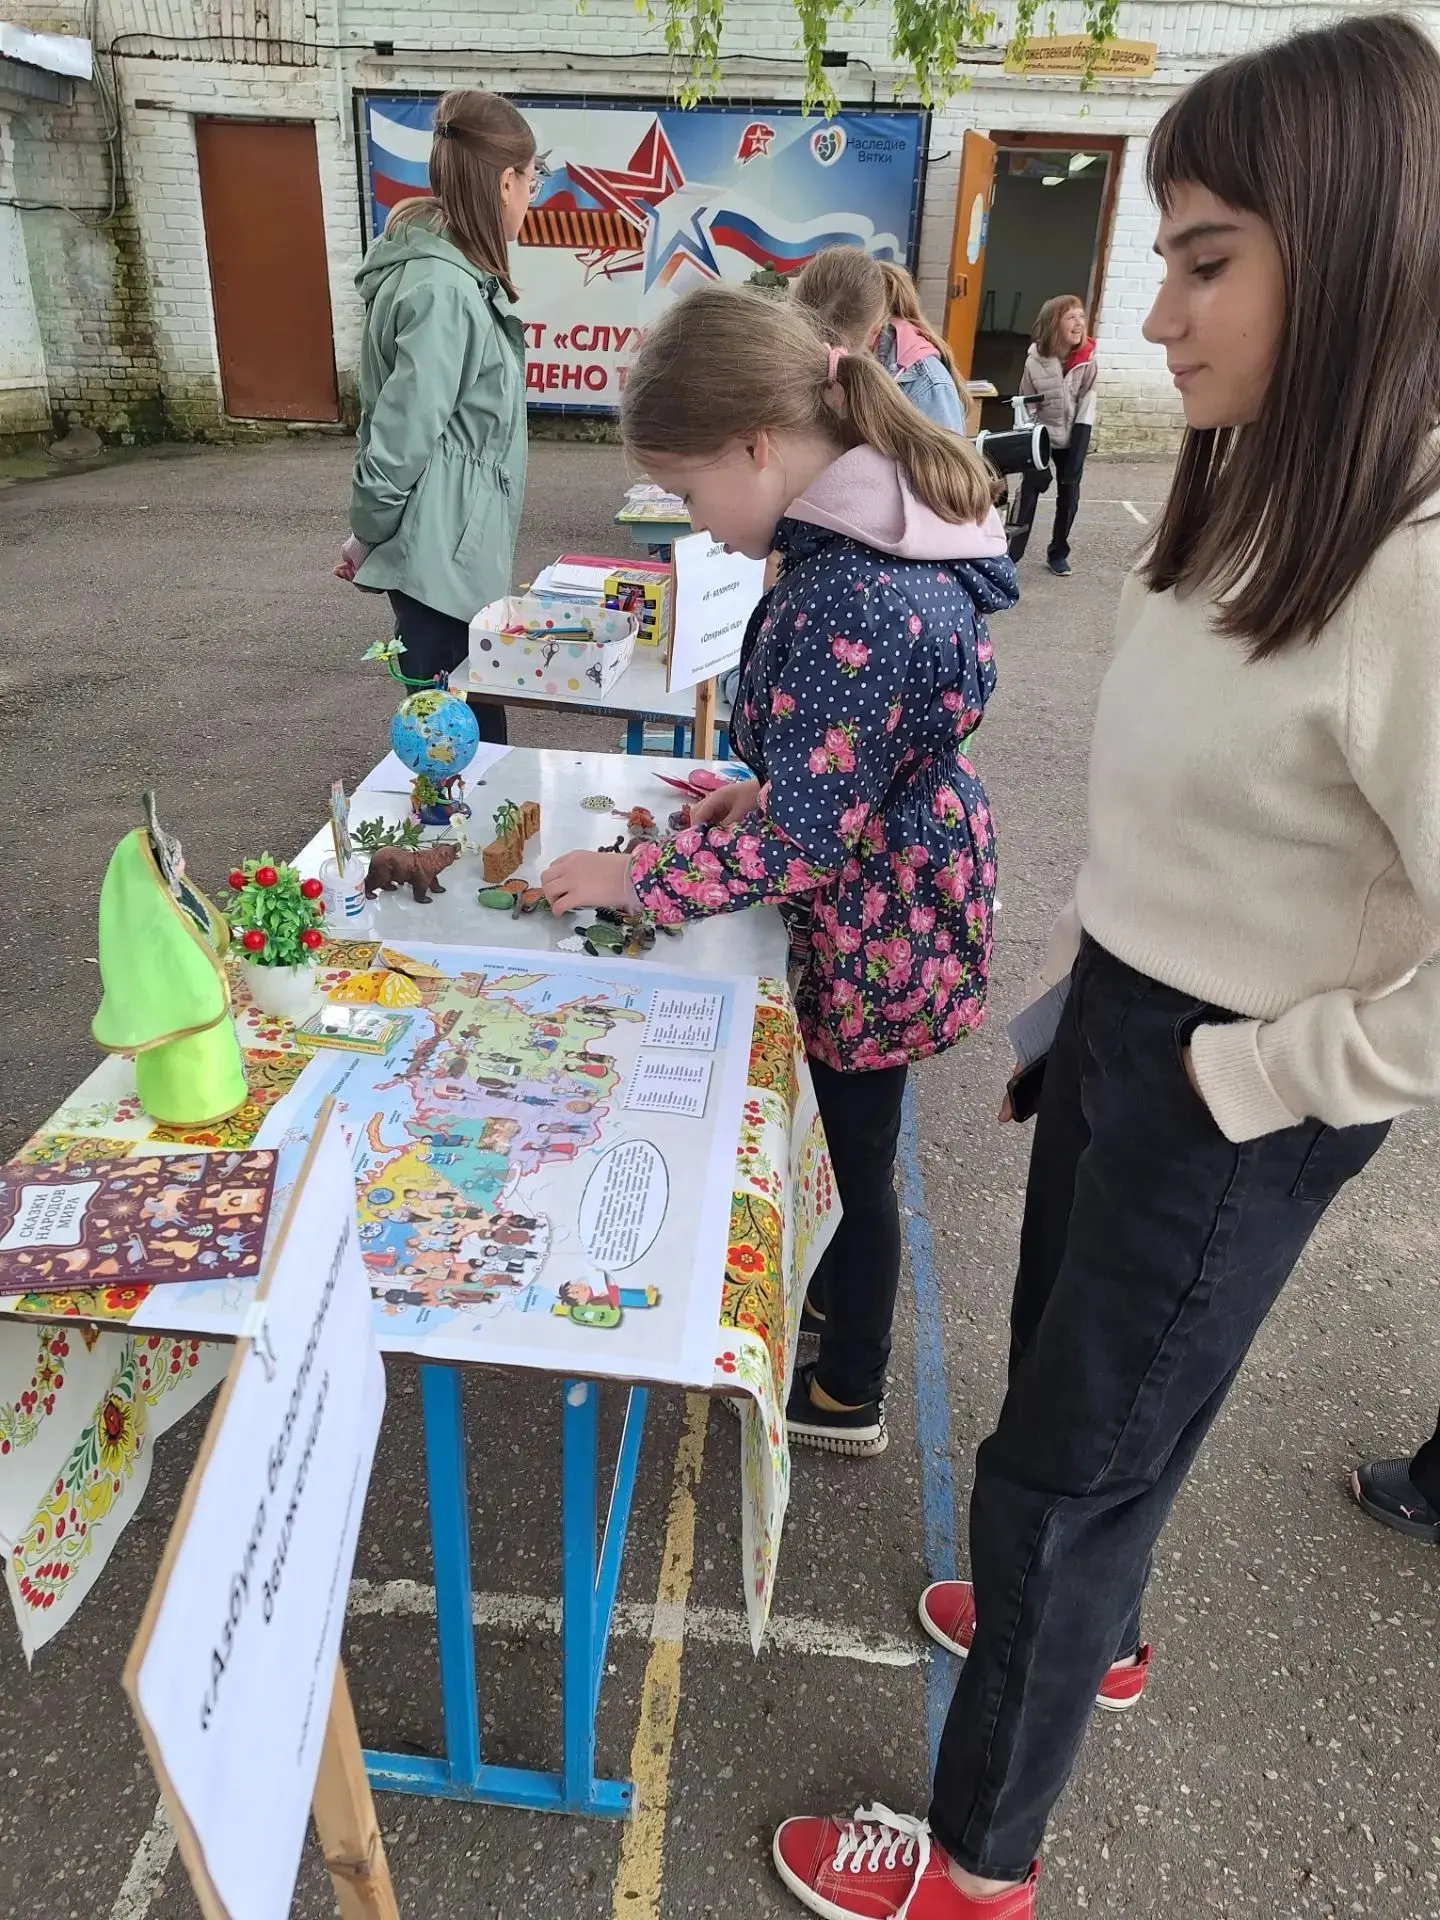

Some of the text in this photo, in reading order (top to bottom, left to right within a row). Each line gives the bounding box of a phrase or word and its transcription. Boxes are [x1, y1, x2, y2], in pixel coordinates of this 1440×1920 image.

[1110, 49, 1150, 66] ДРЕВЕСИНЫ
[846, 137, 906, 151] Наследие
[858, 150, 893, 164] Вятки
[19, 1193, 49, 1239] СКАЗКИ
[35, 1188, 67, 1241] НАРОДОВ
[56, 1196, 81, 1230] МИРА
